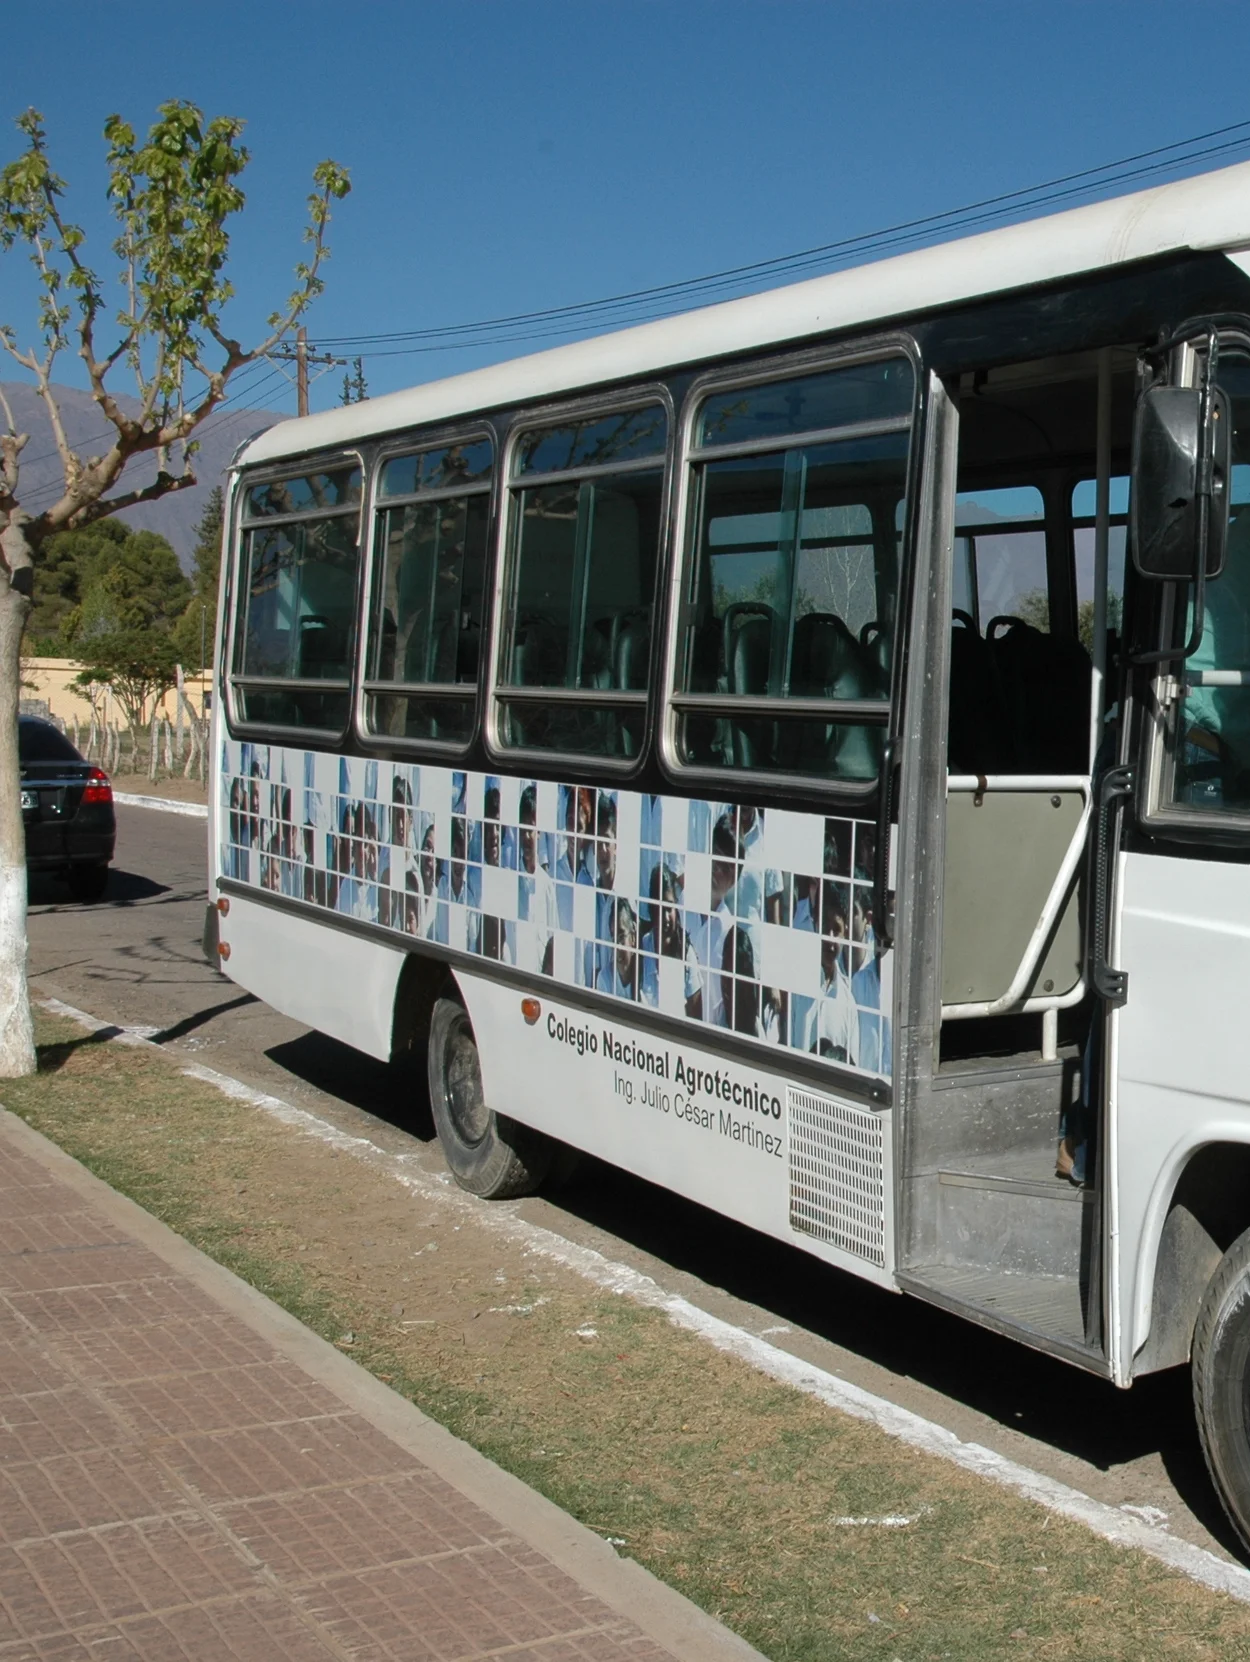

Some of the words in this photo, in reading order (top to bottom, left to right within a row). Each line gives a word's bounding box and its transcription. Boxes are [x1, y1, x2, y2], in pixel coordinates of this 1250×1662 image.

[547, 1012, 598, 1056] Colegio
[603, 1030, 670, 1079] Nacional
[674, 1055, 781, 1120] Agrotécnico
[614, 1070, 639, 1105] Ing.
[640, 1080, 671, 1113] Julio
[674, 1093, 715, 1130] César
